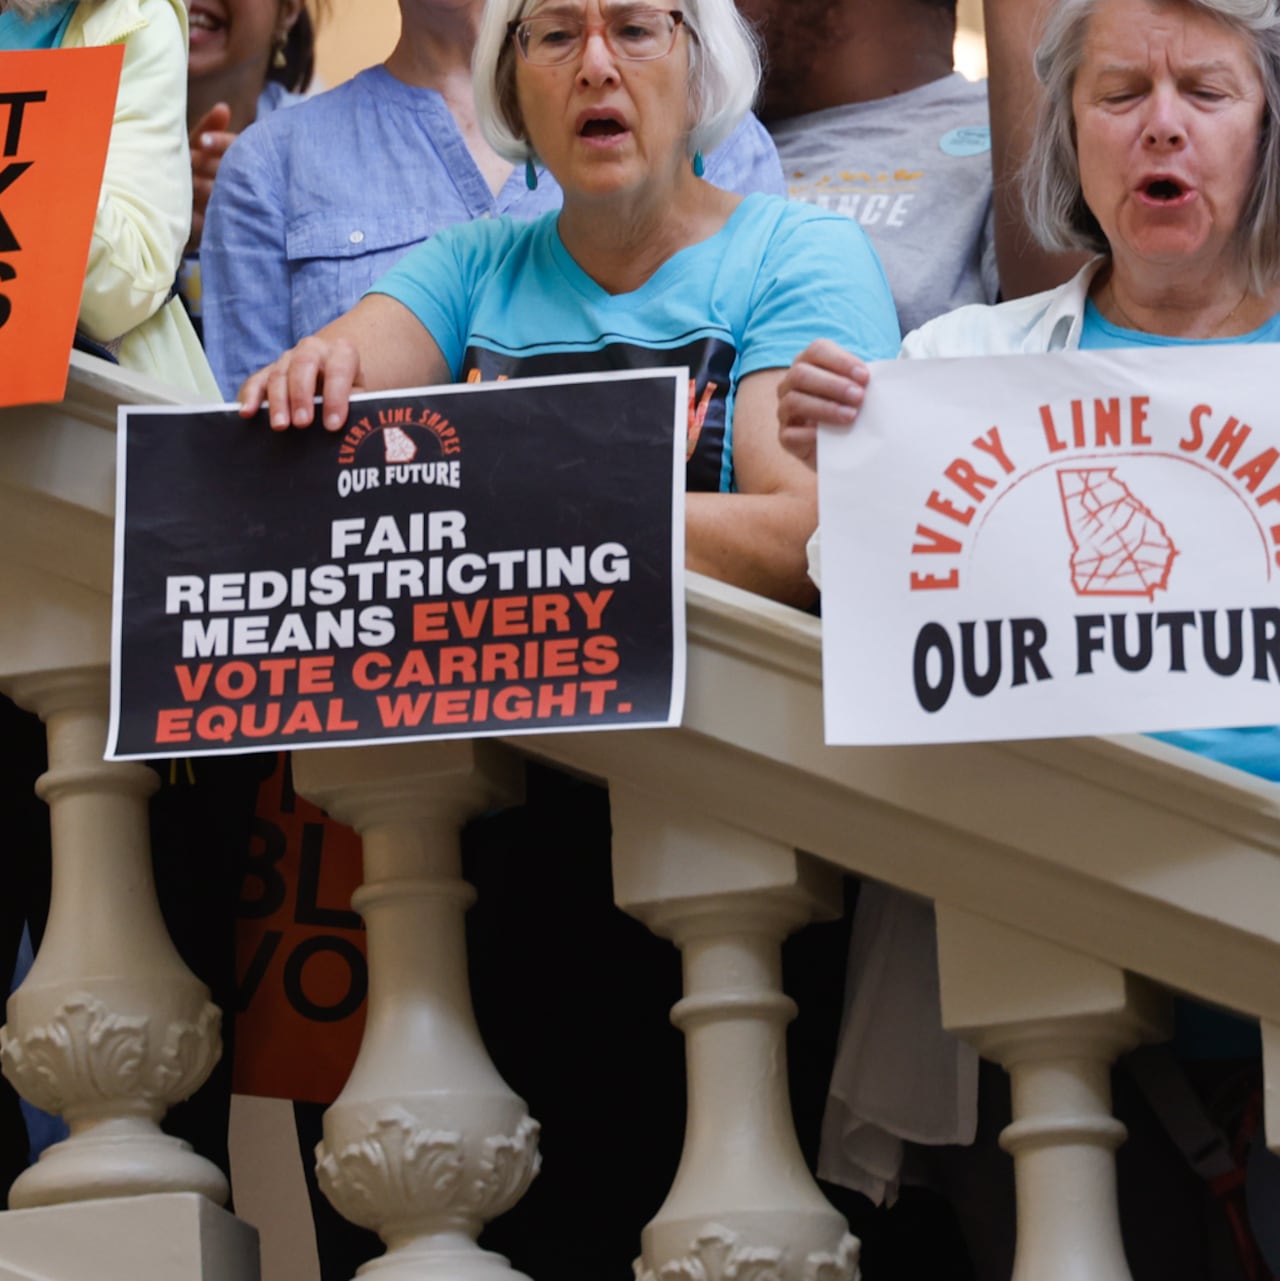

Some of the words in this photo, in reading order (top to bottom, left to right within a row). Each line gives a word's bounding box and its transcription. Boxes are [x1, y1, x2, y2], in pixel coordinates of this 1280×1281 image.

[338, 417, 372, 464] EVERY
[378, 407, 413, 424] LINE
[419, 409, 461, 455] SHAPES
[337, 466, 380, 498] OUR
[385, 460, 460, 488] FUTURE
[910, 426, 1016, 592] EVERY
[1038, 396, 1152, 453] LINE
[331, 511, 466, 559] FAIR
[165, 542, 630, 615] REDISTRICTING
[182, 606, 396, 659] MEANS
[412, 589, 615, 643] EVERY
[175, 656, 335, 703] VOTE
[351, 636, 620, 691] CARRIES
[912, 617, 1053, 714] OUR
[155, 699, 359, 745] EQUAL
[376, 680, 633, 727] WEIGHT.
